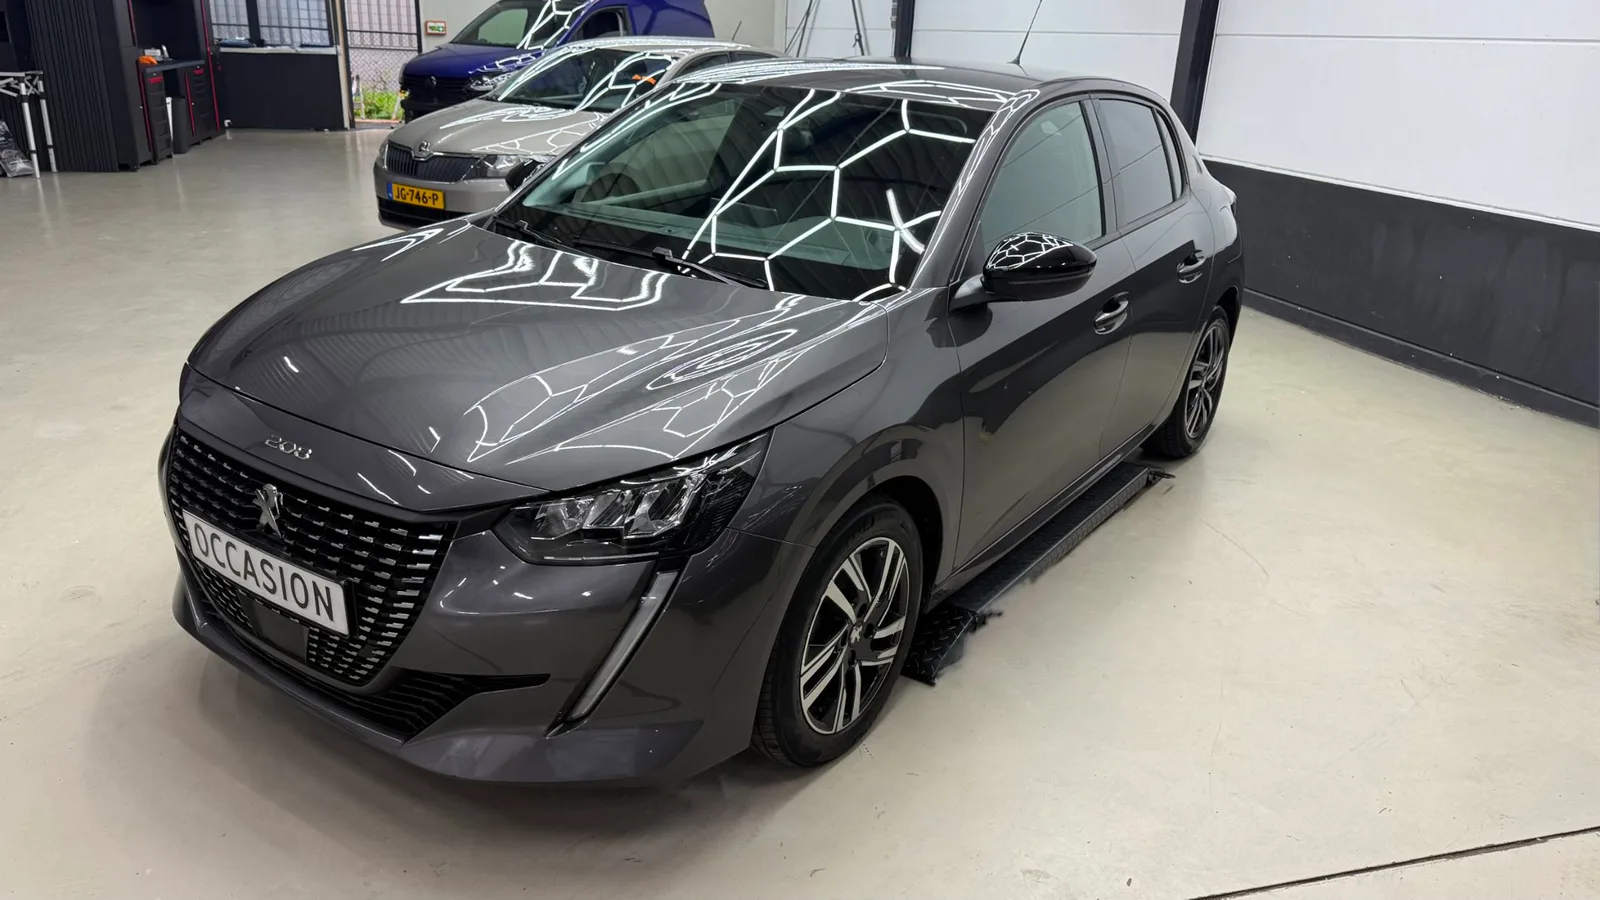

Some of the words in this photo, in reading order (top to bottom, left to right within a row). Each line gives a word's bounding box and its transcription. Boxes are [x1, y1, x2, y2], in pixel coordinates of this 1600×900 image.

[395, 186, 439, 206] JG-746-P
[265, 434, 313, 460] 208
[194, 523, 334, 623] OCCASION
